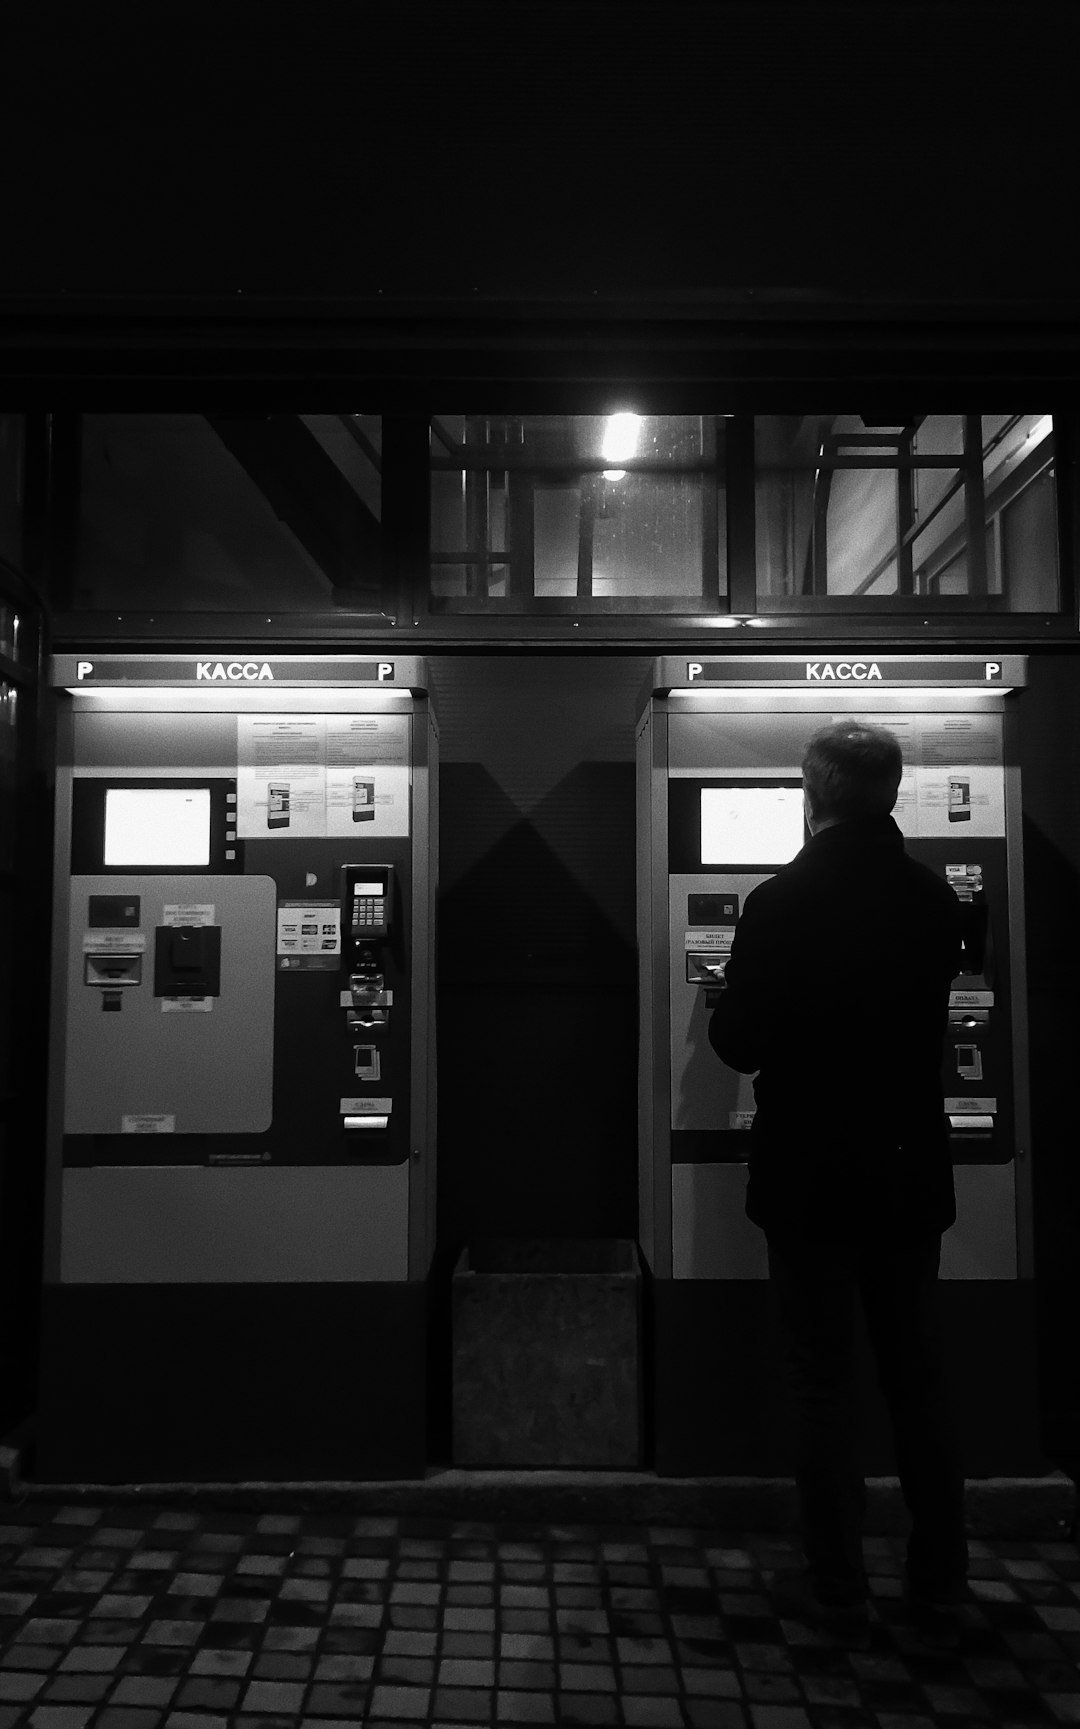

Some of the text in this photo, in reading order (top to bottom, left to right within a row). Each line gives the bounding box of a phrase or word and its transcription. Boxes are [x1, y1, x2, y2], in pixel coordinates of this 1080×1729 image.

[77, 662, 93, 680] P
[195, 662, 275, 680] КАССА
[378, 663, 393, 681] P
[688, 663, 703, 681] P
[805, 662, 883, 680] КАССА
[985, 662, 1000, 681] P
